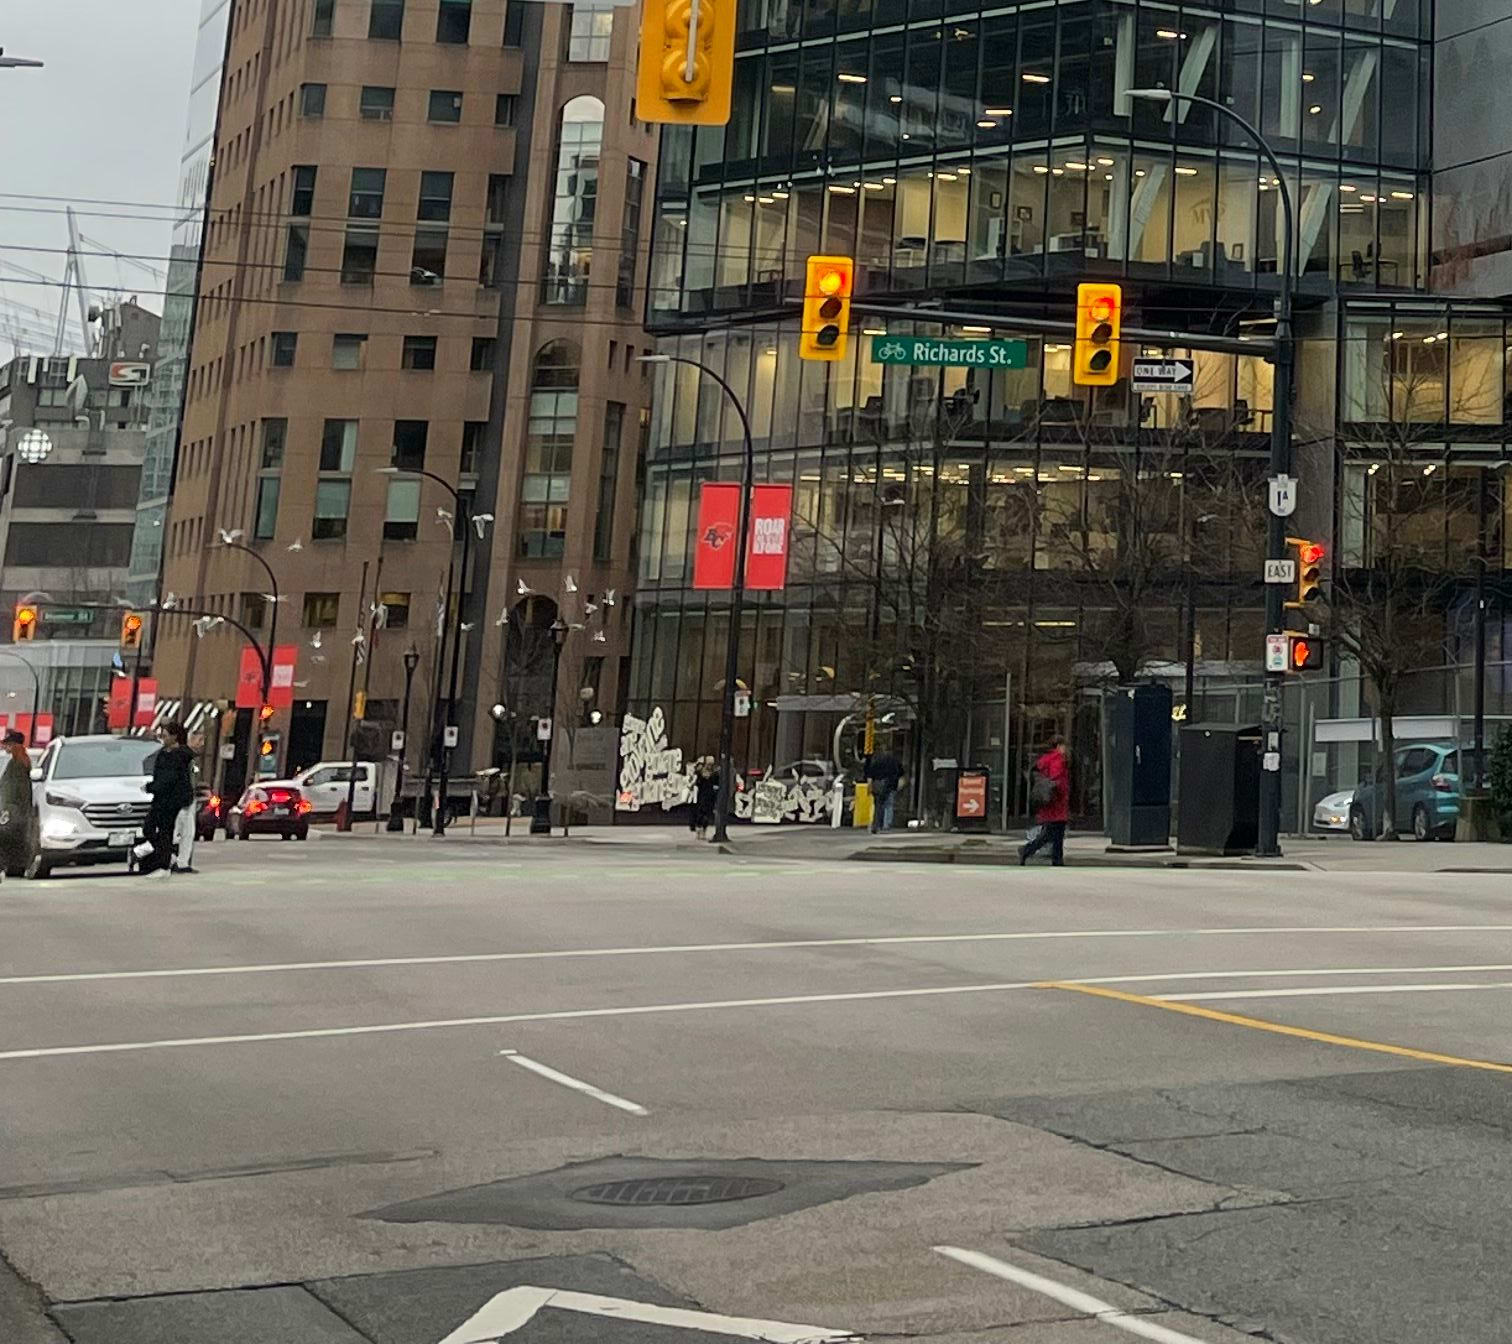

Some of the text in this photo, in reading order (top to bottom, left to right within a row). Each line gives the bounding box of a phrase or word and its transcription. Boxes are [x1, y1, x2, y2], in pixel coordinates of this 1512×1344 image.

[913, 342, 1012, 365] Richards St.
[1137, 367, 1176, 377] ONE WAY
[1267, 564, 1293, 578] EAST
